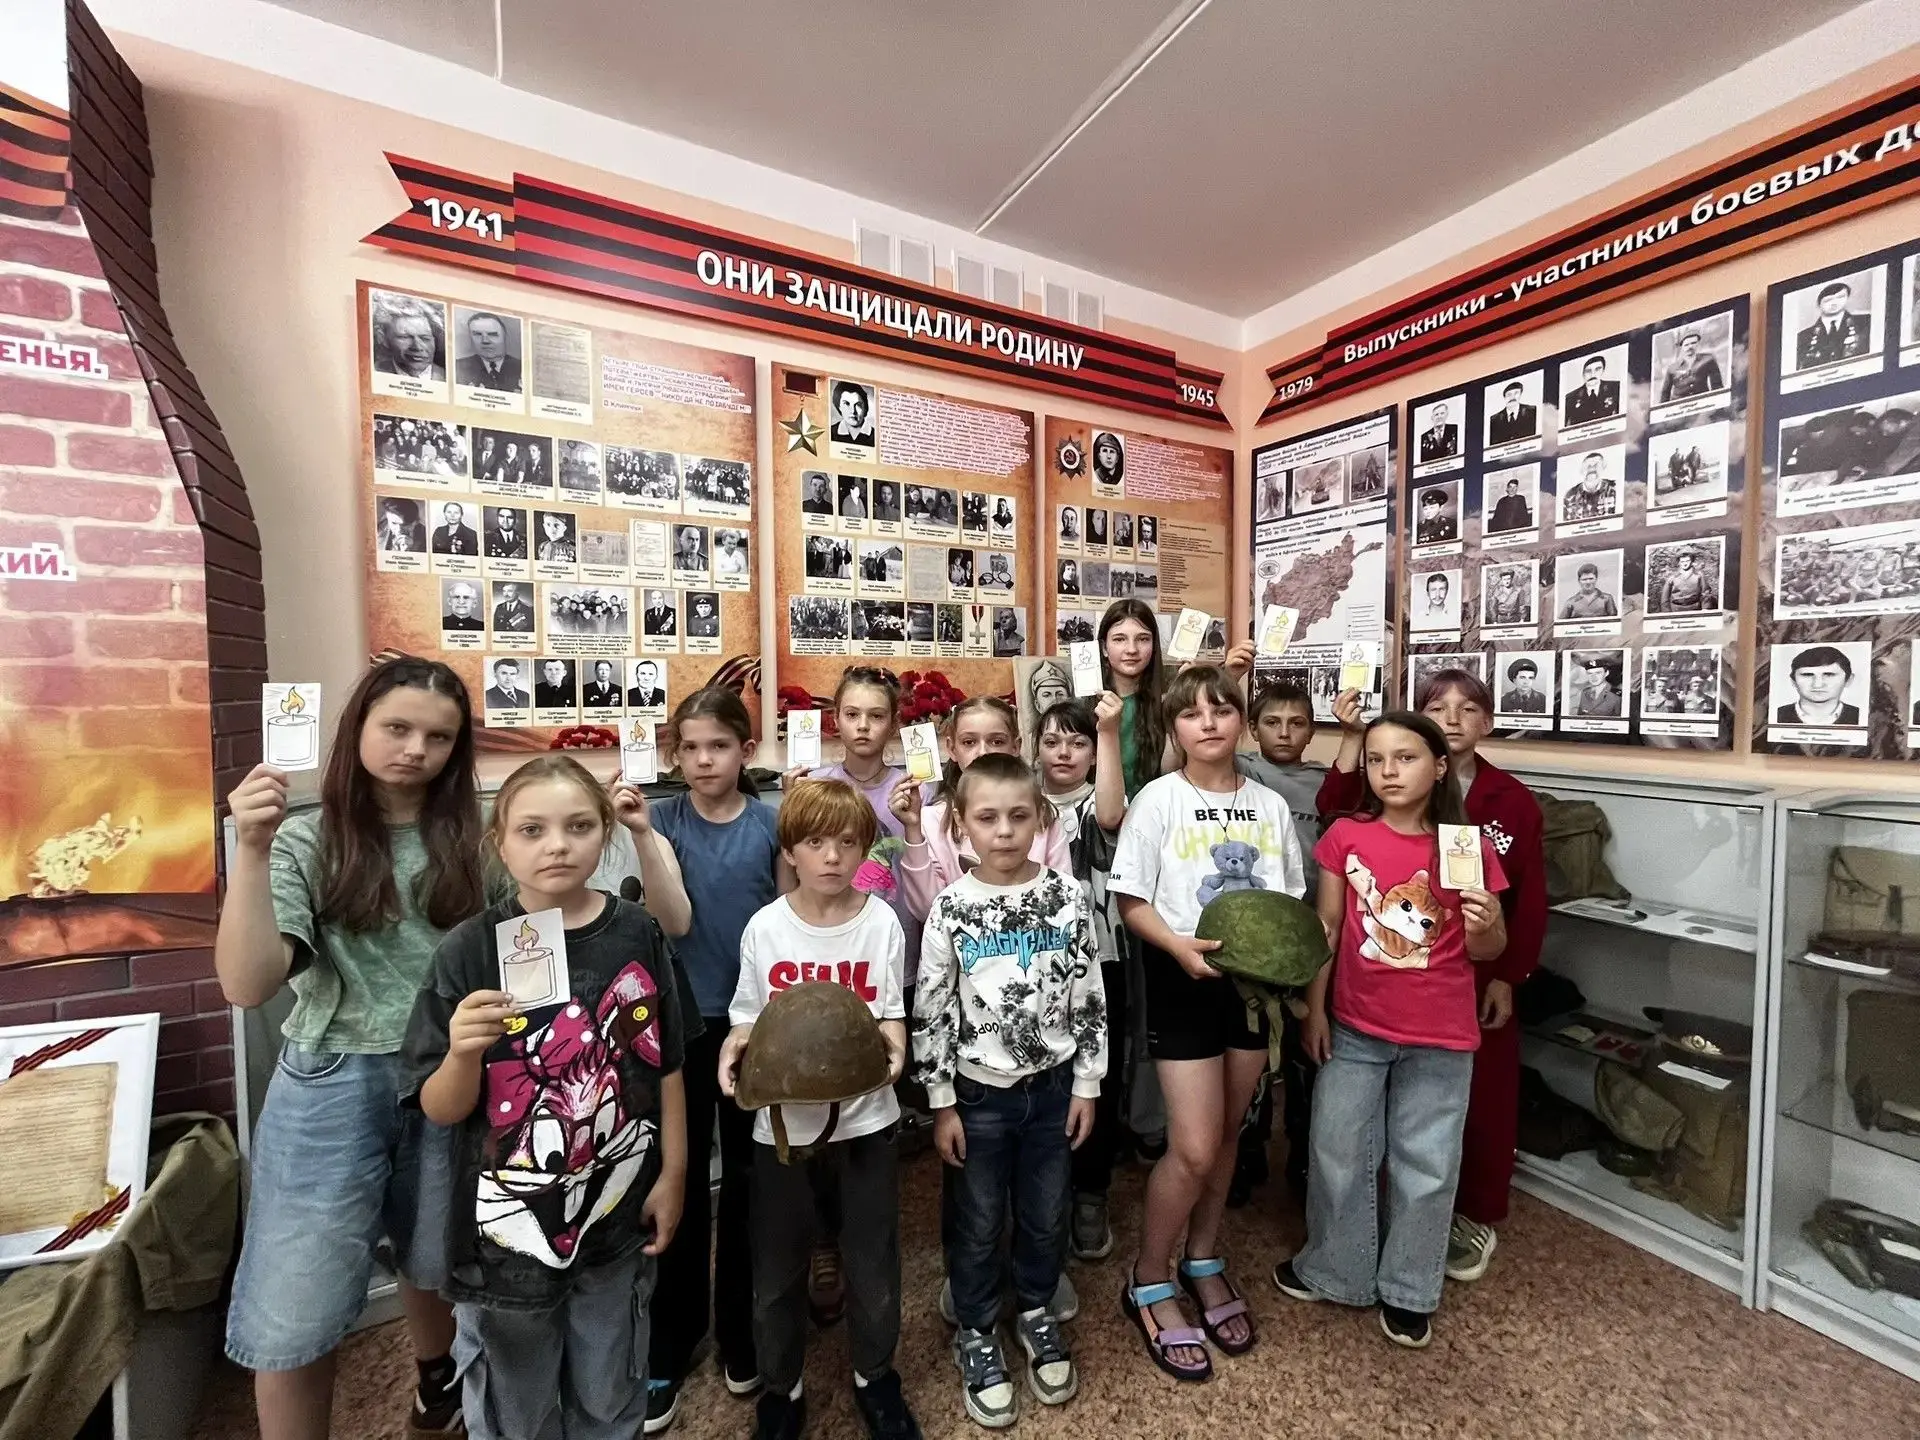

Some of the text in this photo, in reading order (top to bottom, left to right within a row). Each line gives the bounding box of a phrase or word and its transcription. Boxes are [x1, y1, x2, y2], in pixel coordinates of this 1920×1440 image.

[424, 197, 502, 242] 1941
[1344, 294, 1486, 363] Выпускники
[1510, 215, 1679, 302] участники
[1690, 141, 1863, 225] боевых
[696, 250, 1085, 372] ОНИ ЗАЩИЩАЛИ РОДИНУ
[1180, 383, 1215, 407] 1945
[1278, 376, 1314, 401] 1979
[1195, 807, 1258, 822] BE THE
